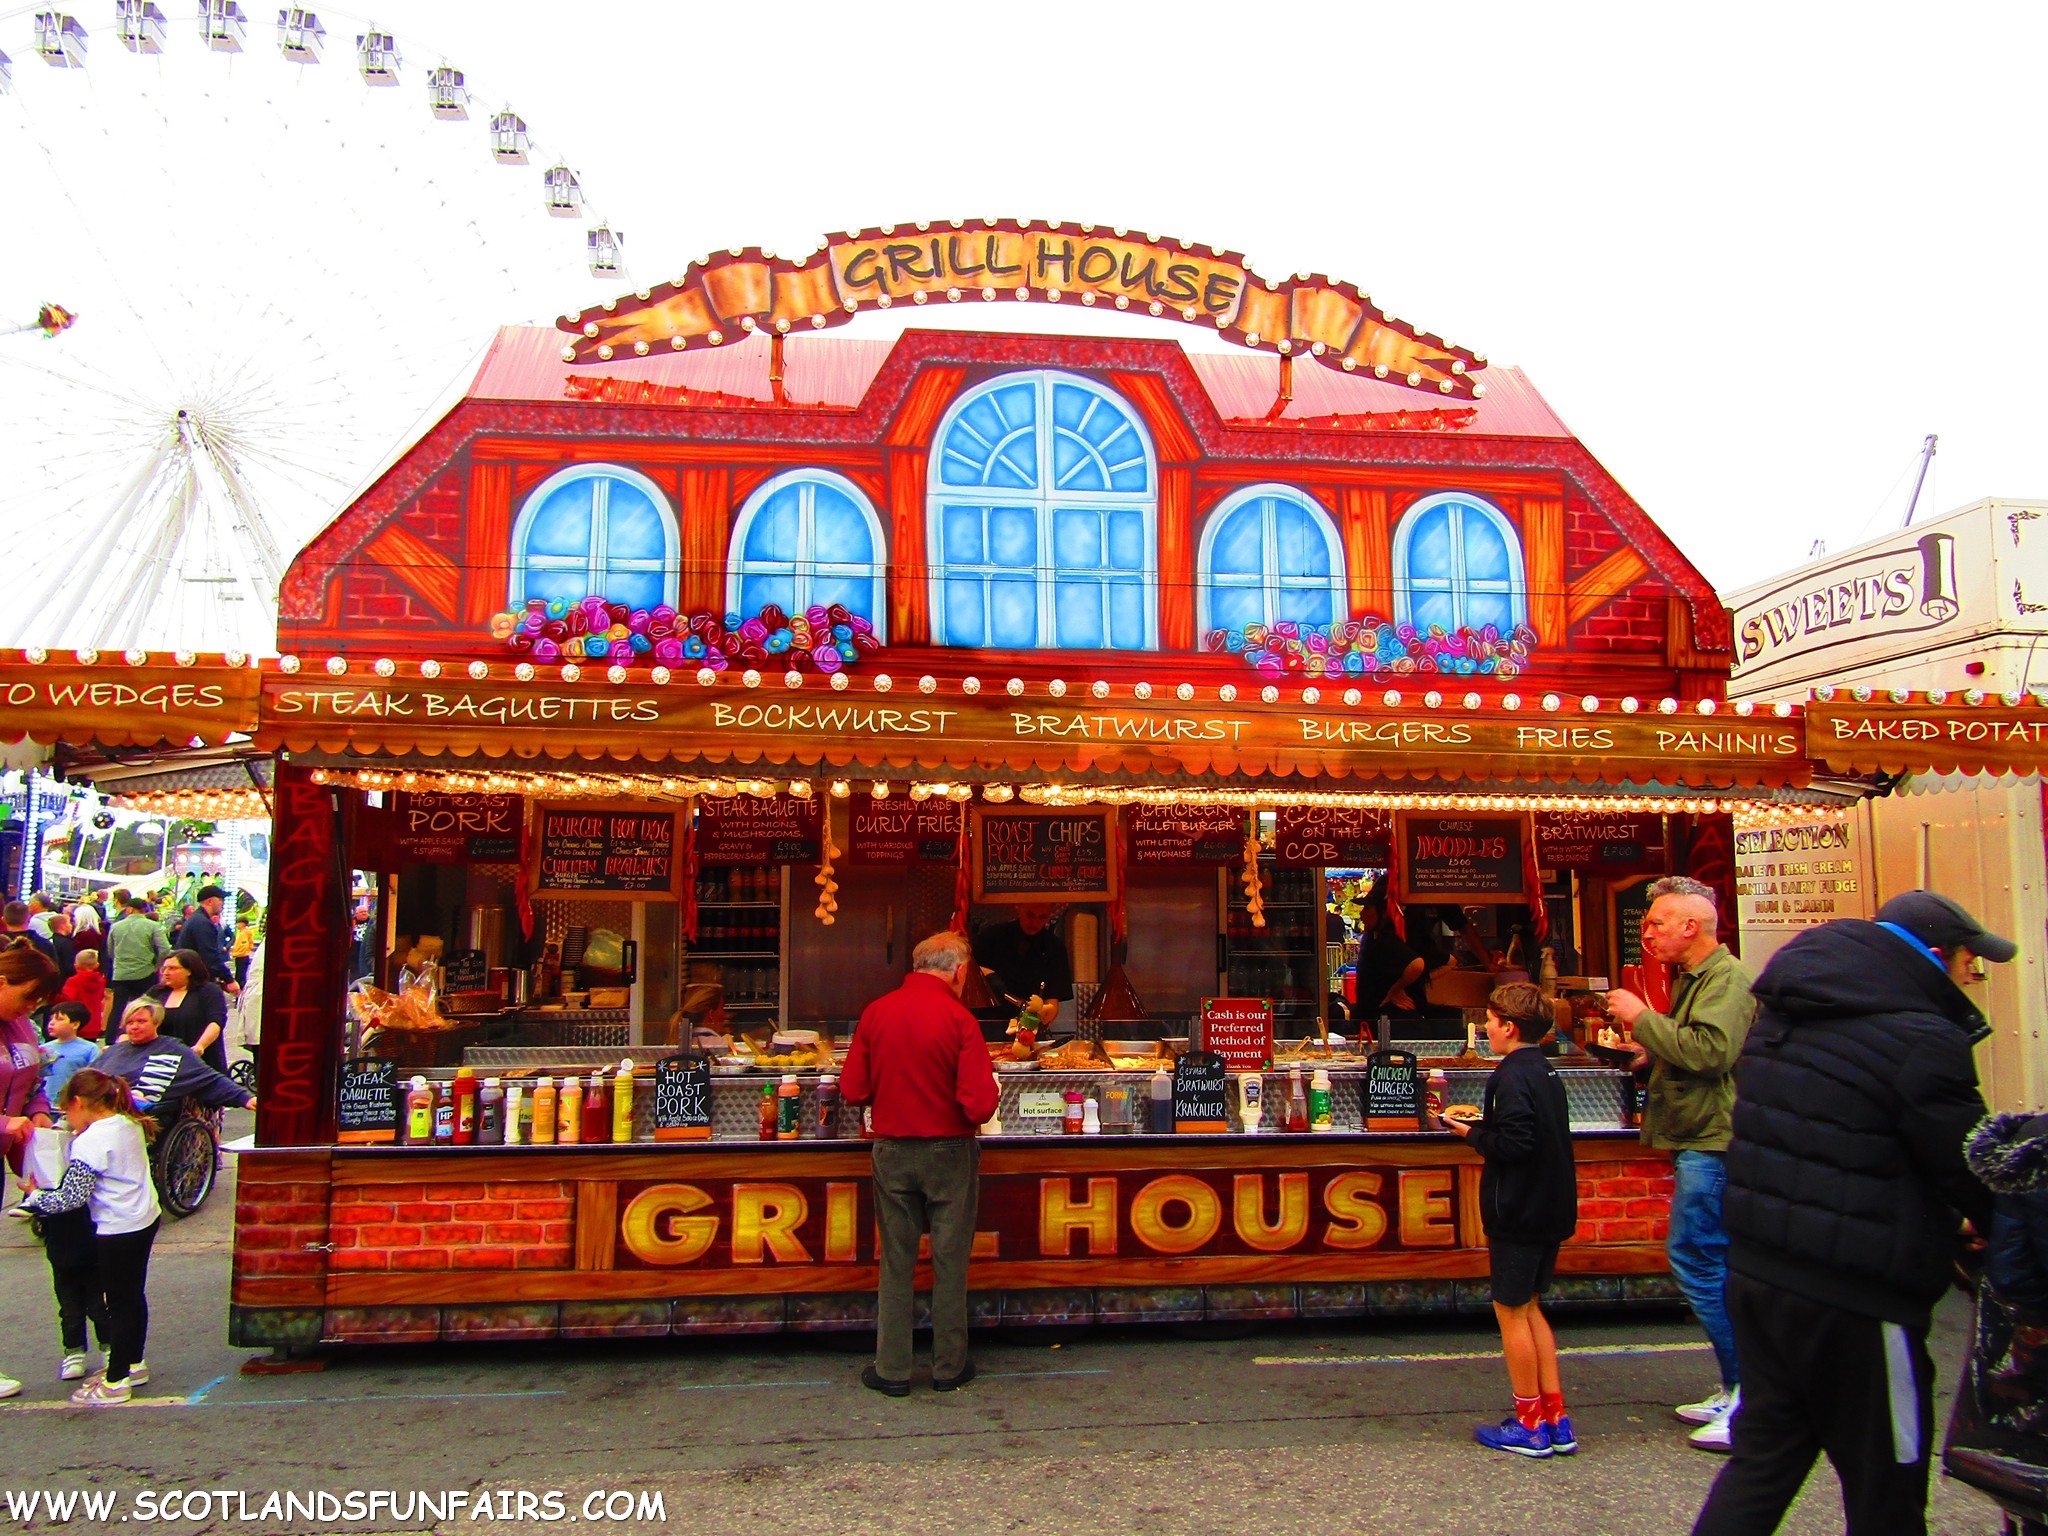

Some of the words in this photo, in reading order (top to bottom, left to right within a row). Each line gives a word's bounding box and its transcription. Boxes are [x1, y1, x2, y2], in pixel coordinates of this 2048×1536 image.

[844, 235, 1022, 294] GRILL
[1038, 238, 1241, 312] HOUSE
[1741, 566, 1915, 662] SWEETS
[0, 683, 36, 706] O
[48, 683, 224, 713] WEDGES
[274, 691, 413, 716] STEAK
[425, 694, 661, 724] BAGUETTES
[711, 702, 958, 733] BOCKWURST
[1011, 713, 1252, 742] BRATWURST
[1298, 718, 1472, 748] BURGERS
[1830, 717, 1941, 743] BAKED
[1947, 720, 2048, 744] POTAT
[1516, 726, 1615, 750] FRIES
[1656, 730, 1798, 755] PANINI'S
[410, 796, 450, 807] HOT
[451, 796, 516, 807] ROAST
[705, 800, 749, 817] STEAK
[751, 799, 818, 818] BAGUETTE
[871, 801, 920, 811] FRESHLY
[922, 801, 953, 811] MADE
[1141, 804, 1231, 818] CHICKEN
[1286, 806, 1382, 825] CORN
[408, 810, 512, 832] PORK
[548, 816, 604, 838] BURGER
[720, 821, 749, 829] WITH
[752, 821, 798, 829] ONIONS
[856, 815, 912, 834] CURLY
[917, 815, 963, 834] FRIES
[1136, 820, 1179, 832] FILLET
[1181, 819, 1236, 833] BURGER
[610, 817, 640, 839] HOT
[641, 819, 671, 843] DOG
[723, 831, 804, 839] MUSHROOMS,
[987, 821, 1040, 843] ROAST
[1048, 820, 1102, 843] CHIPS
[1302, 828, 1325, 838] ON
[1330, 828, 1361, 838] THE
[1541, 825, 1639, 840] BRATWURST
[718, 843, 745, 851] GRAVY
[857, 842, 878, 850] WITH
[879, 841, 914, 850] VARIOUS
[1136, 839, 1157, 847] WITH
[1158, 839, 1193, 847] LETTUCE
[1736, 823, 1850, 855] SELECTION
[419, 847, 452, 855] STUFFING
[704, 852, 743, 860] PEPPERCORN
[744, 852, 767, 860] SAUCE
[867, 851, 905, 861] TOPPINGS
[988, 844, 1036, 864] PORK
[1144, 850, 1192, 860] MAYONAISE
[1286, 843, 1339, 860] COB
[1415, 835, 1508, 861] NOODLES
[1542, 846, 1559, 854] WITH
[1565, 845, 1594, 853] WITHOUT
[543, 856, 598, 875] CHICKEN
[1779, 862, 1809, 876] IRISH
[1812, 860, 1853, 875] CREAM
[1781, 881, 1817, 894] DAIRY
[1820, 879, 1858, 893] FUDGE
[1755, 901, 1779, 913] RUM
[1795, 900, 1835, 913] RAISIN
[266, 784, 327, 1113] BAGUETTES
[1207, 1010, 1233, 1020] Cash
[1236, 1010, 1245, 1020] is
[1247, 1012, 1267, 1020] our
[1211, 1023, 1264, 1033] Preferred
[1210, 1036, 1251, 1046] Method
[1253, 1036, 1266, 1046] of
[1213, 1049, 1262, 1061] Payment
[344, 1069, 396, 1088] STEAK
[665, 1071, 697, 1085] HOT
[1371, 1066, 1413, 1081] CHICKEN
[658, 1083, 705, 1097] ROAST
[1177, 1078, 1225, 1092] BRATWURST
[1369, 1080, 1414, 1096] BURGERS
[657, 1096, 706, 1116] PORK
[1023, 1107, 1036, 1115] Hot
[1037, 1107, 1063, 1115] surface
[1175, 1099, 1223, 1118] KRAKAUER
[440, 1112, 454, 1121] HP
[622, 1183, 1000, 1265] GRI
[1040, 1171, 1456, 1257] HOUSE
